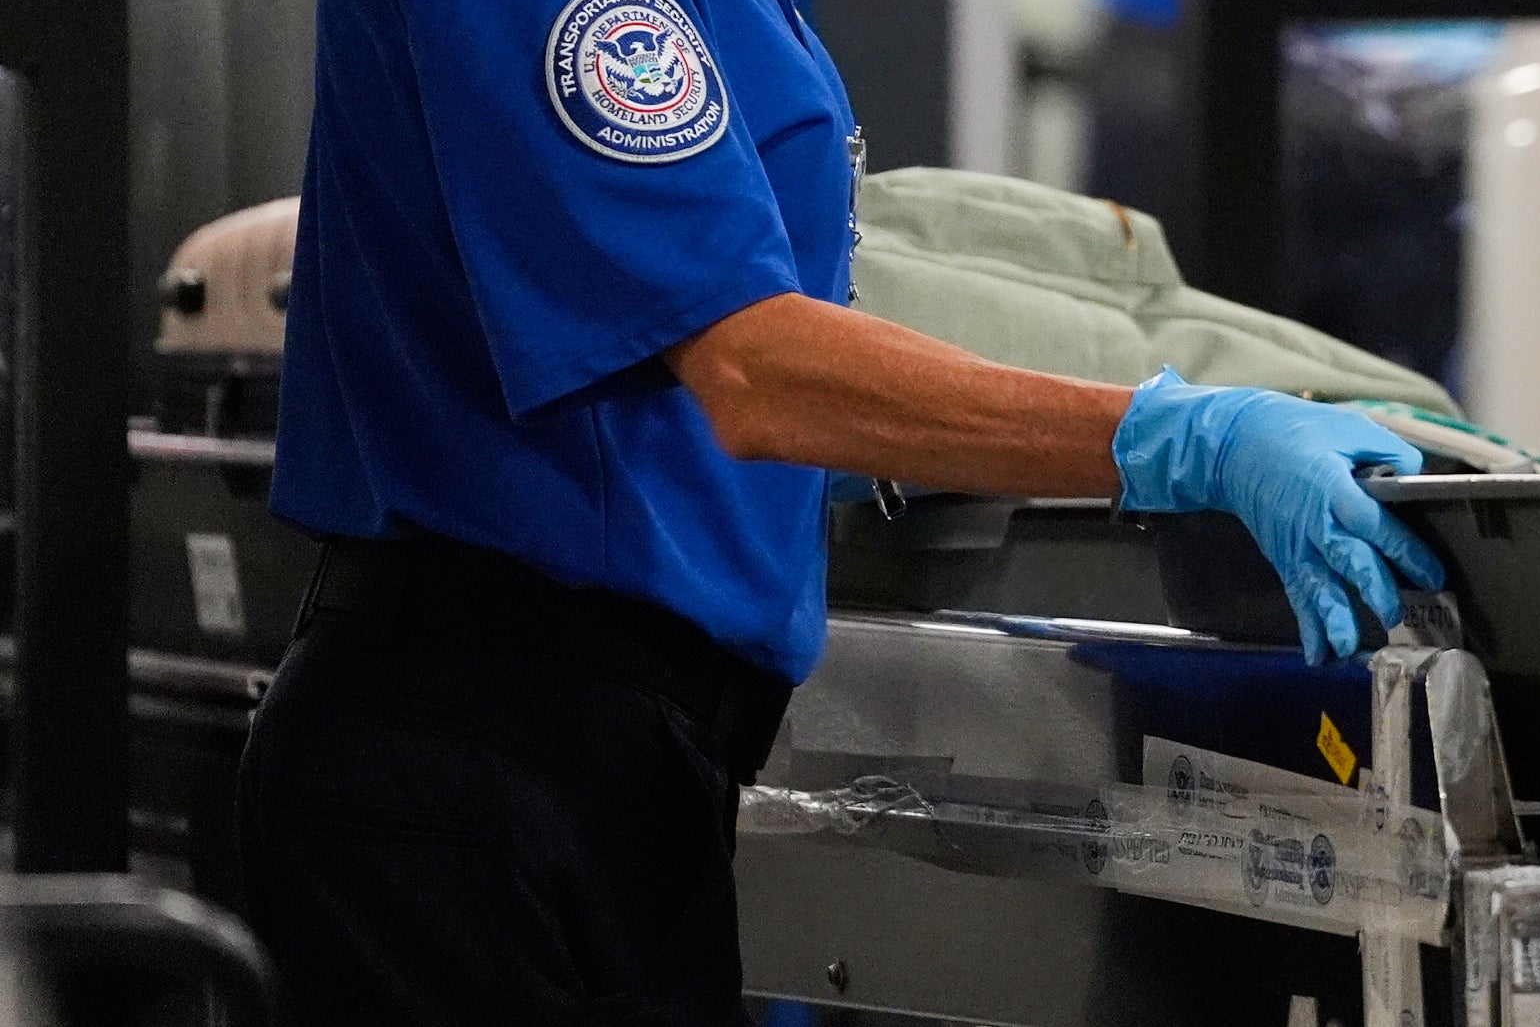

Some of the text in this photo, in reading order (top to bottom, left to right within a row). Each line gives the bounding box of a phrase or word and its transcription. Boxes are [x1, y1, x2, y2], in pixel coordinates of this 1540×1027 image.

[592, 10, 675, 40] DEPARTMENT
[676, 37, 691, 55] OF
[592, 68, 700, 125] HOMELAND SECURITY
[597, 100, 721, 149] ADMINISTRATION
